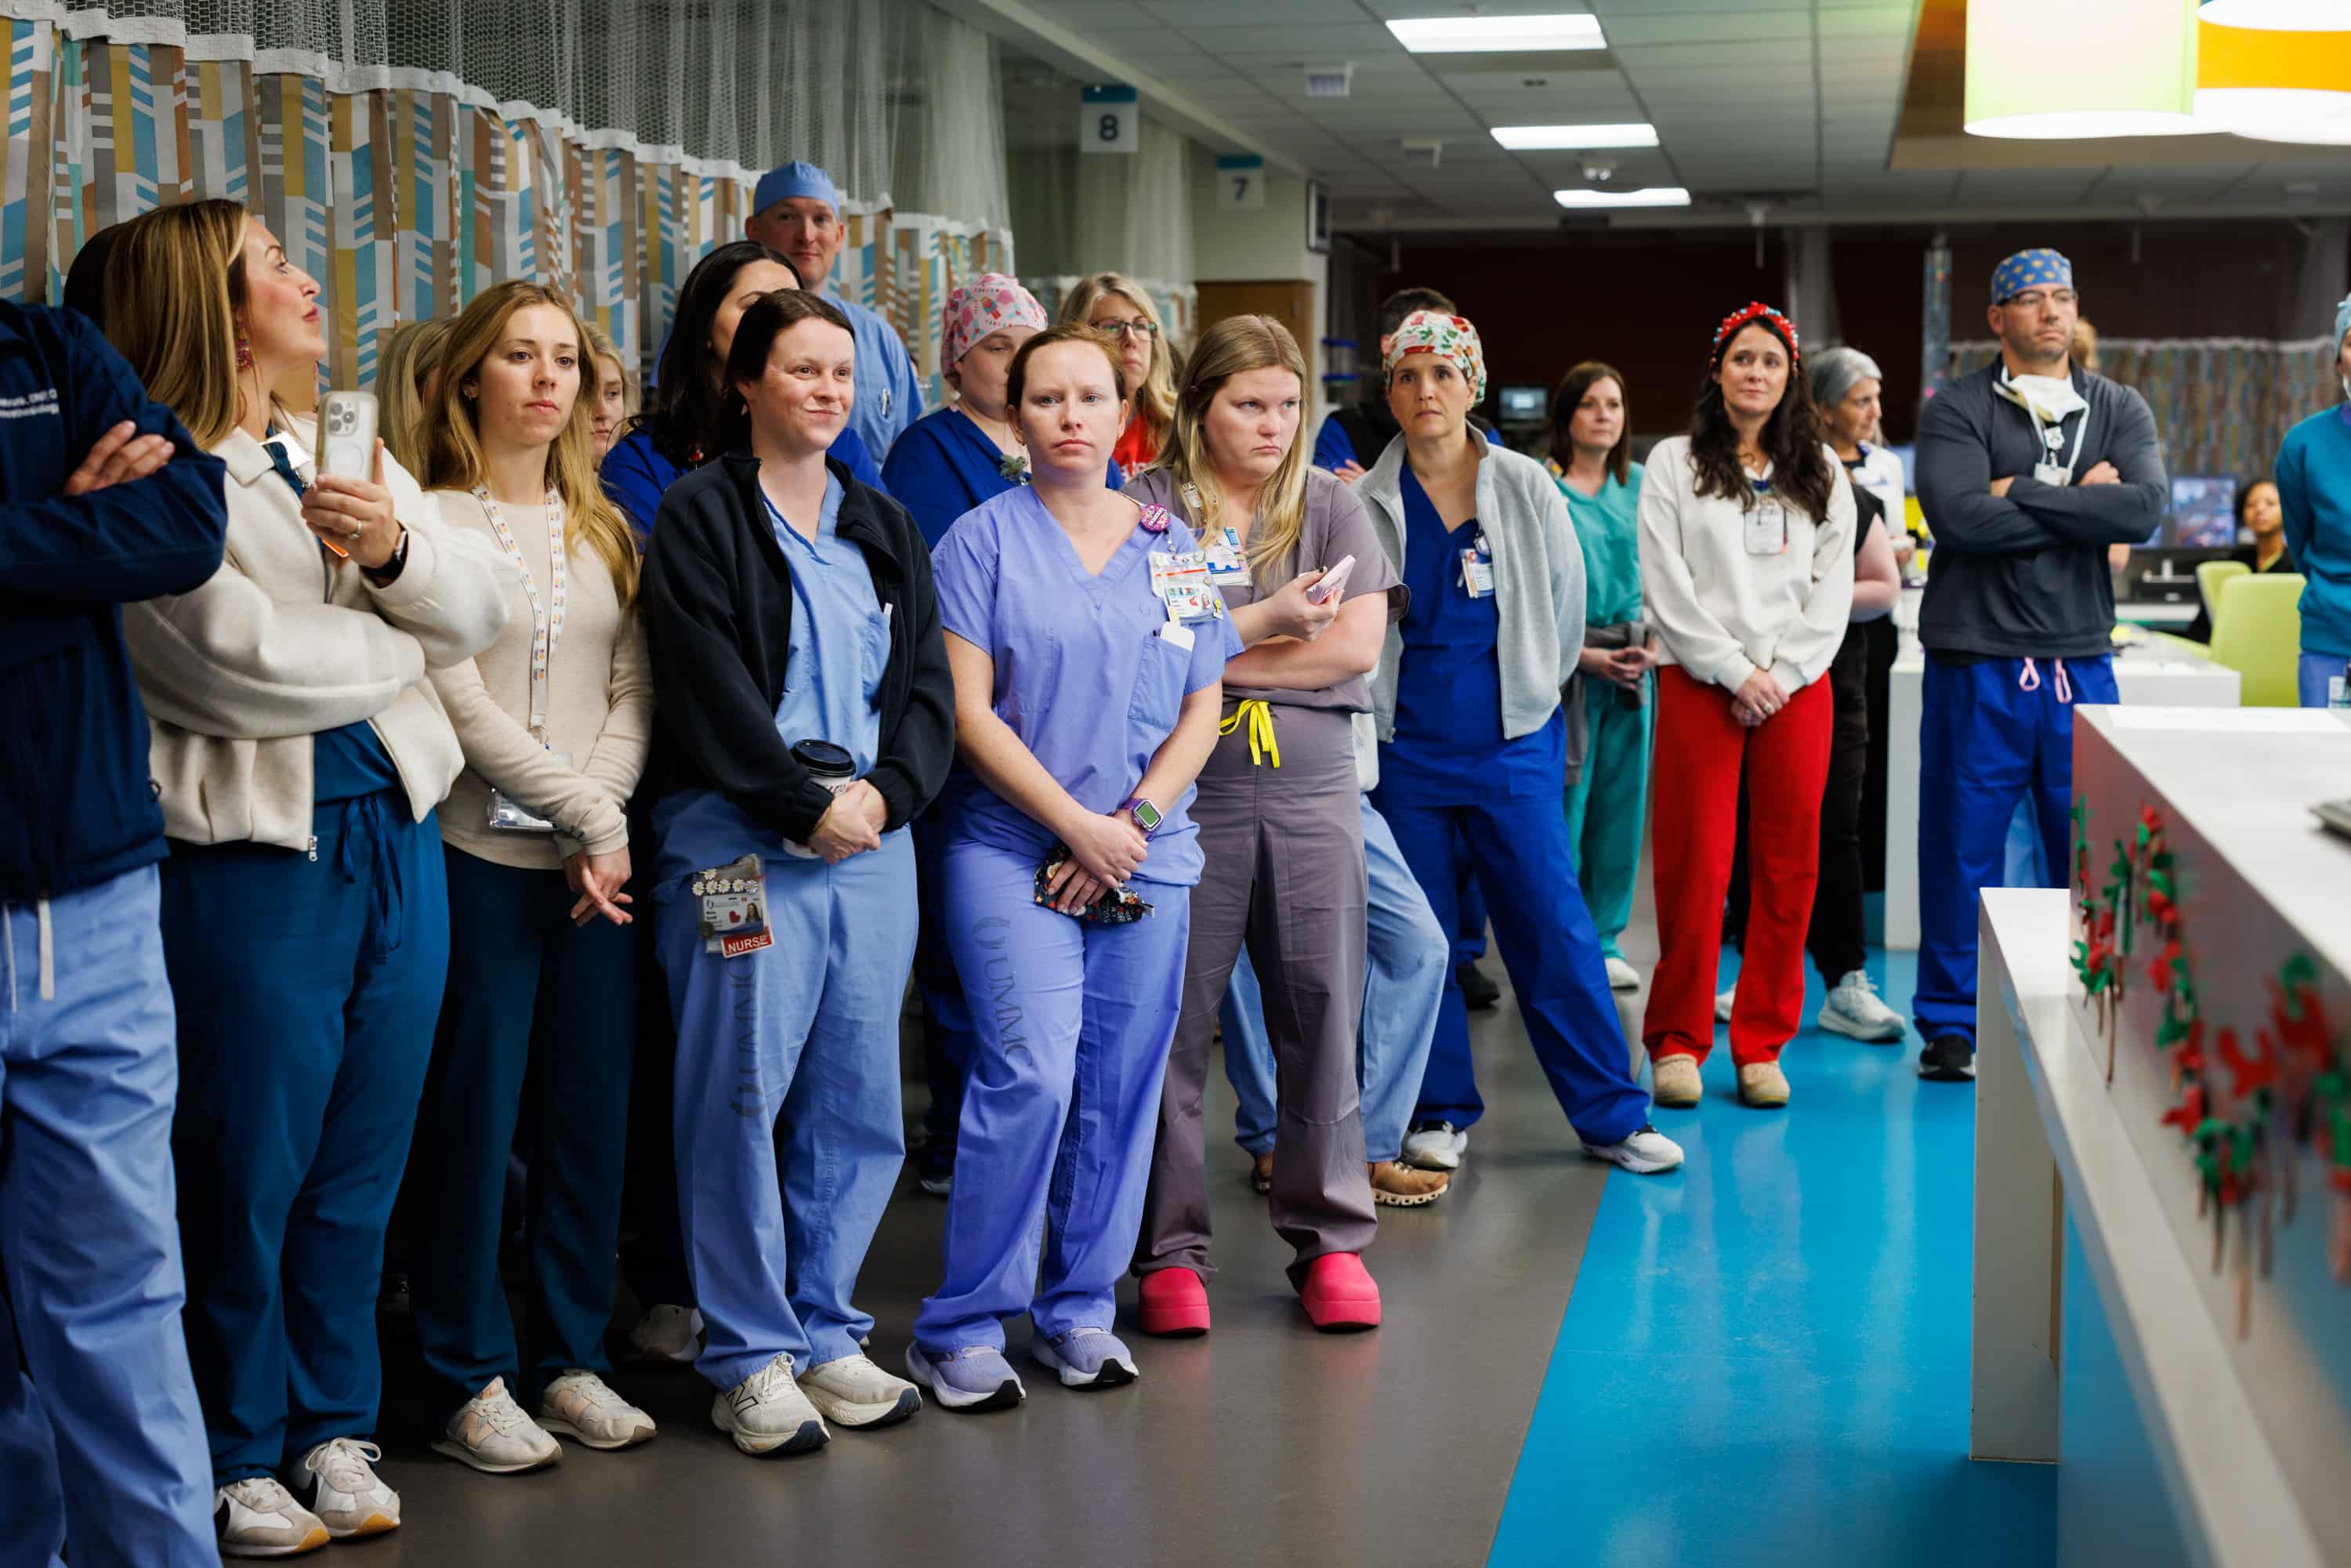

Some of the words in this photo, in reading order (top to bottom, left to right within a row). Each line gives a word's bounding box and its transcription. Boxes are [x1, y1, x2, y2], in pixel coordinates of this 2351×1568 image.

[1099, 114, 1119, 142] 8
[1231, 176, 1249, 201] 7
[727, 935, 768, 954] NURSE
[984, 952, 1034, 1067] UMMC
